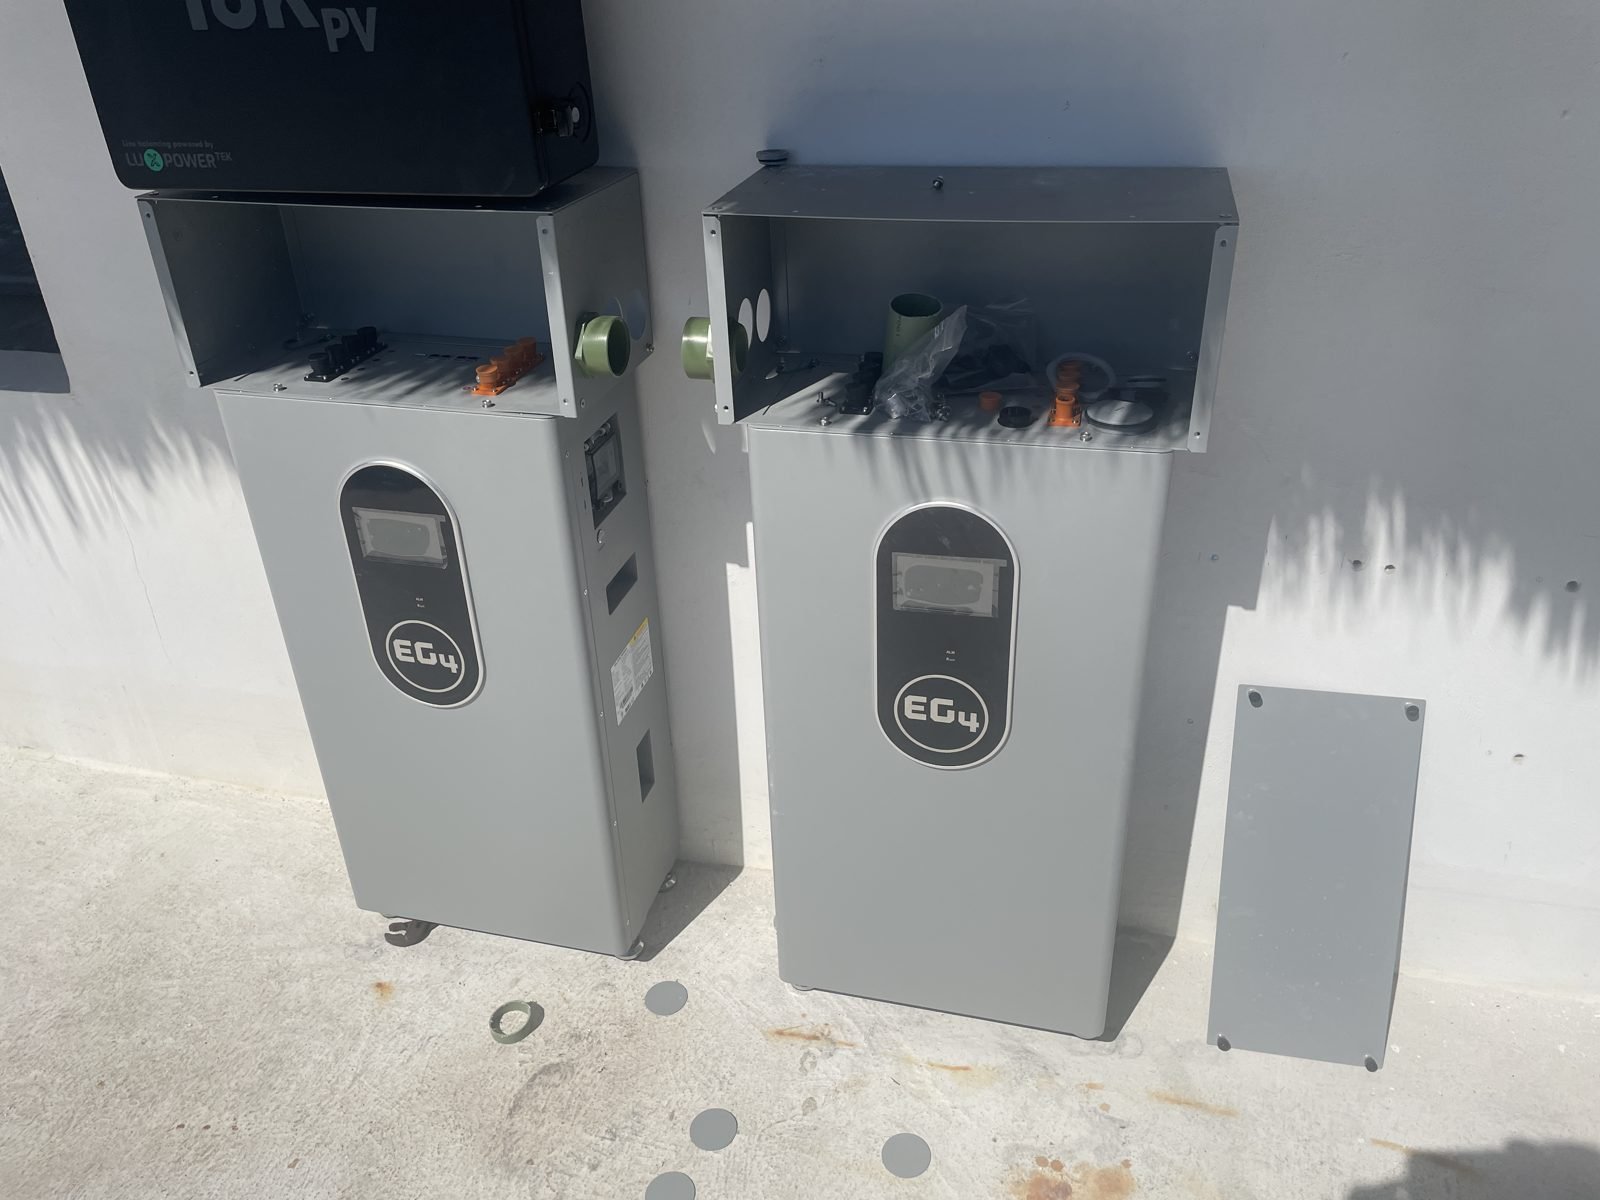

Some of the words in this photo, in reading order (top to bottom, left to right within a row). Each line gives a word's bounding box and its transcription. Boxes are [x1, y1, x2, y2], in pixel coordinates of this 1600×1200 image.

[321, 7, 377, 52] PV
[393, 638, 459, 674] EG4
[904, 694, 980, 733] EG4
